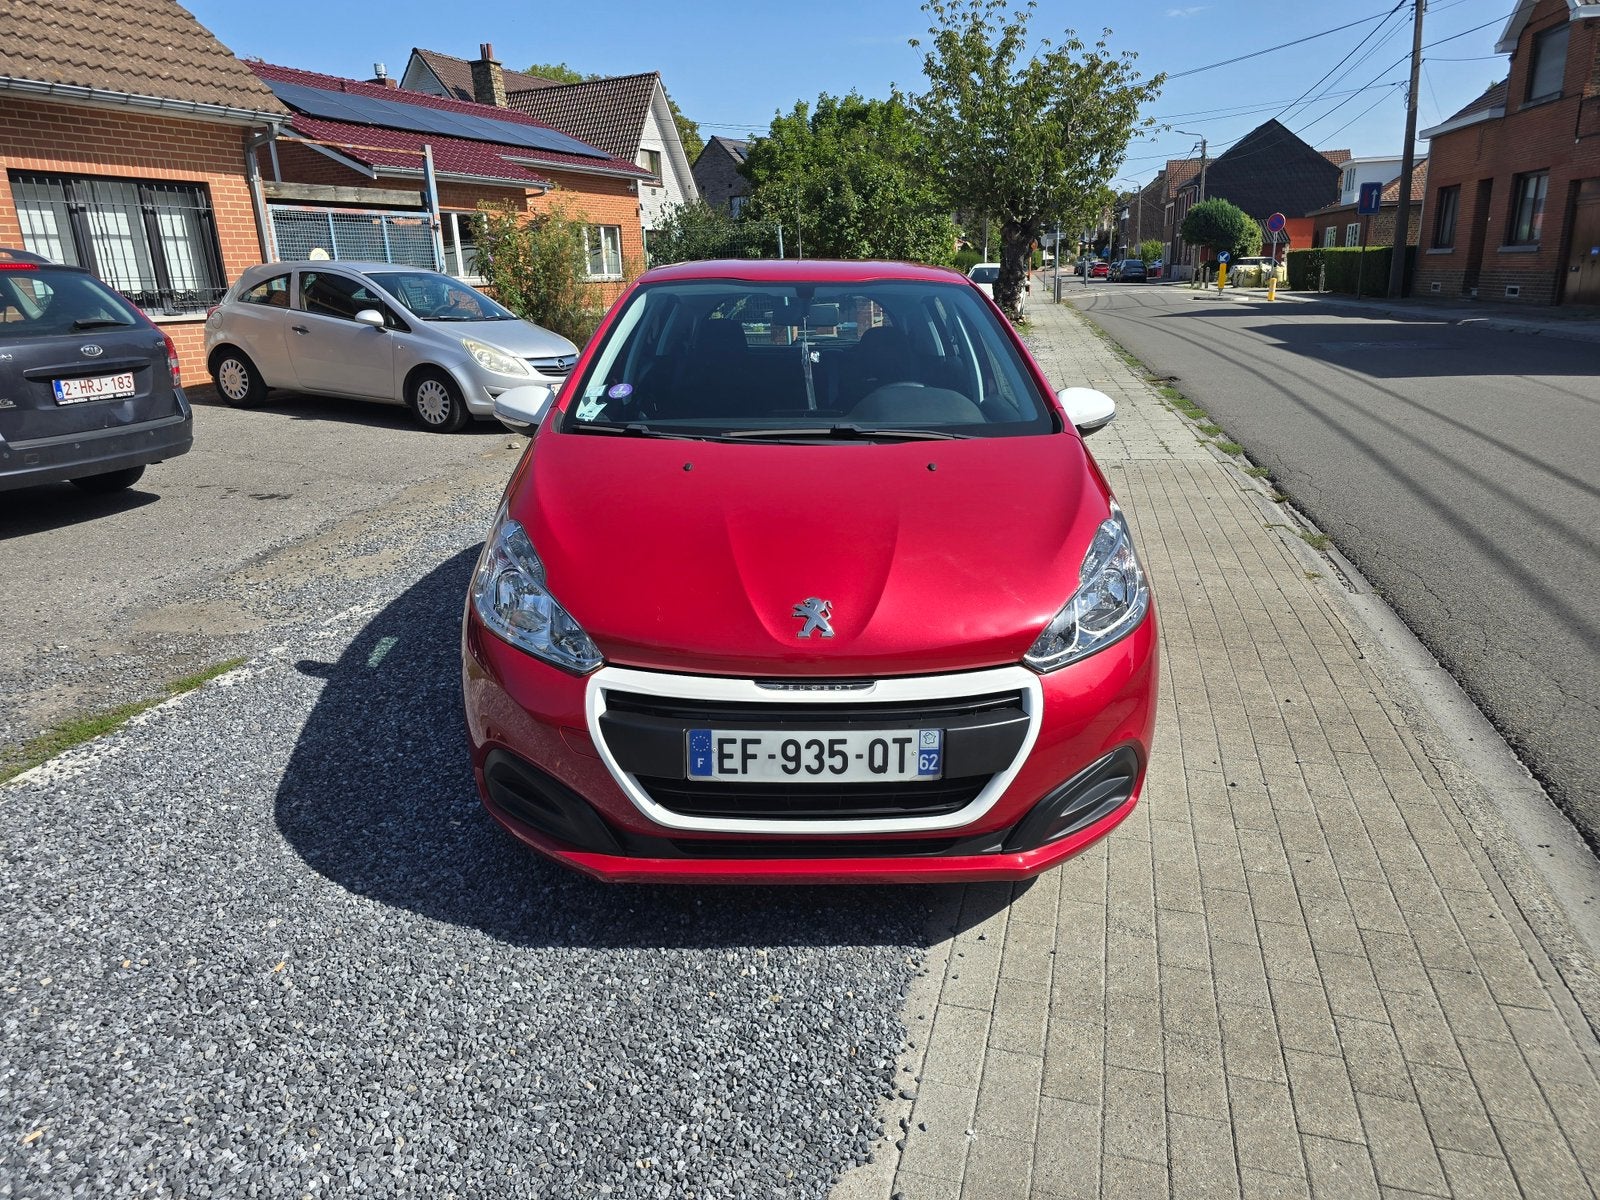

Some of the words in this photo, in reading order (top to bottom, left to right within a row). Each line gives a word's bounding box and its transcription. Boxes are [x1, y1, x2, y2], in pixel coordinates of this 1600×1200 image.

[697, 758, 704, 768] F
[717, 737, 912, 775] EF-935-QT
[919, 753, 939, 770] 62
